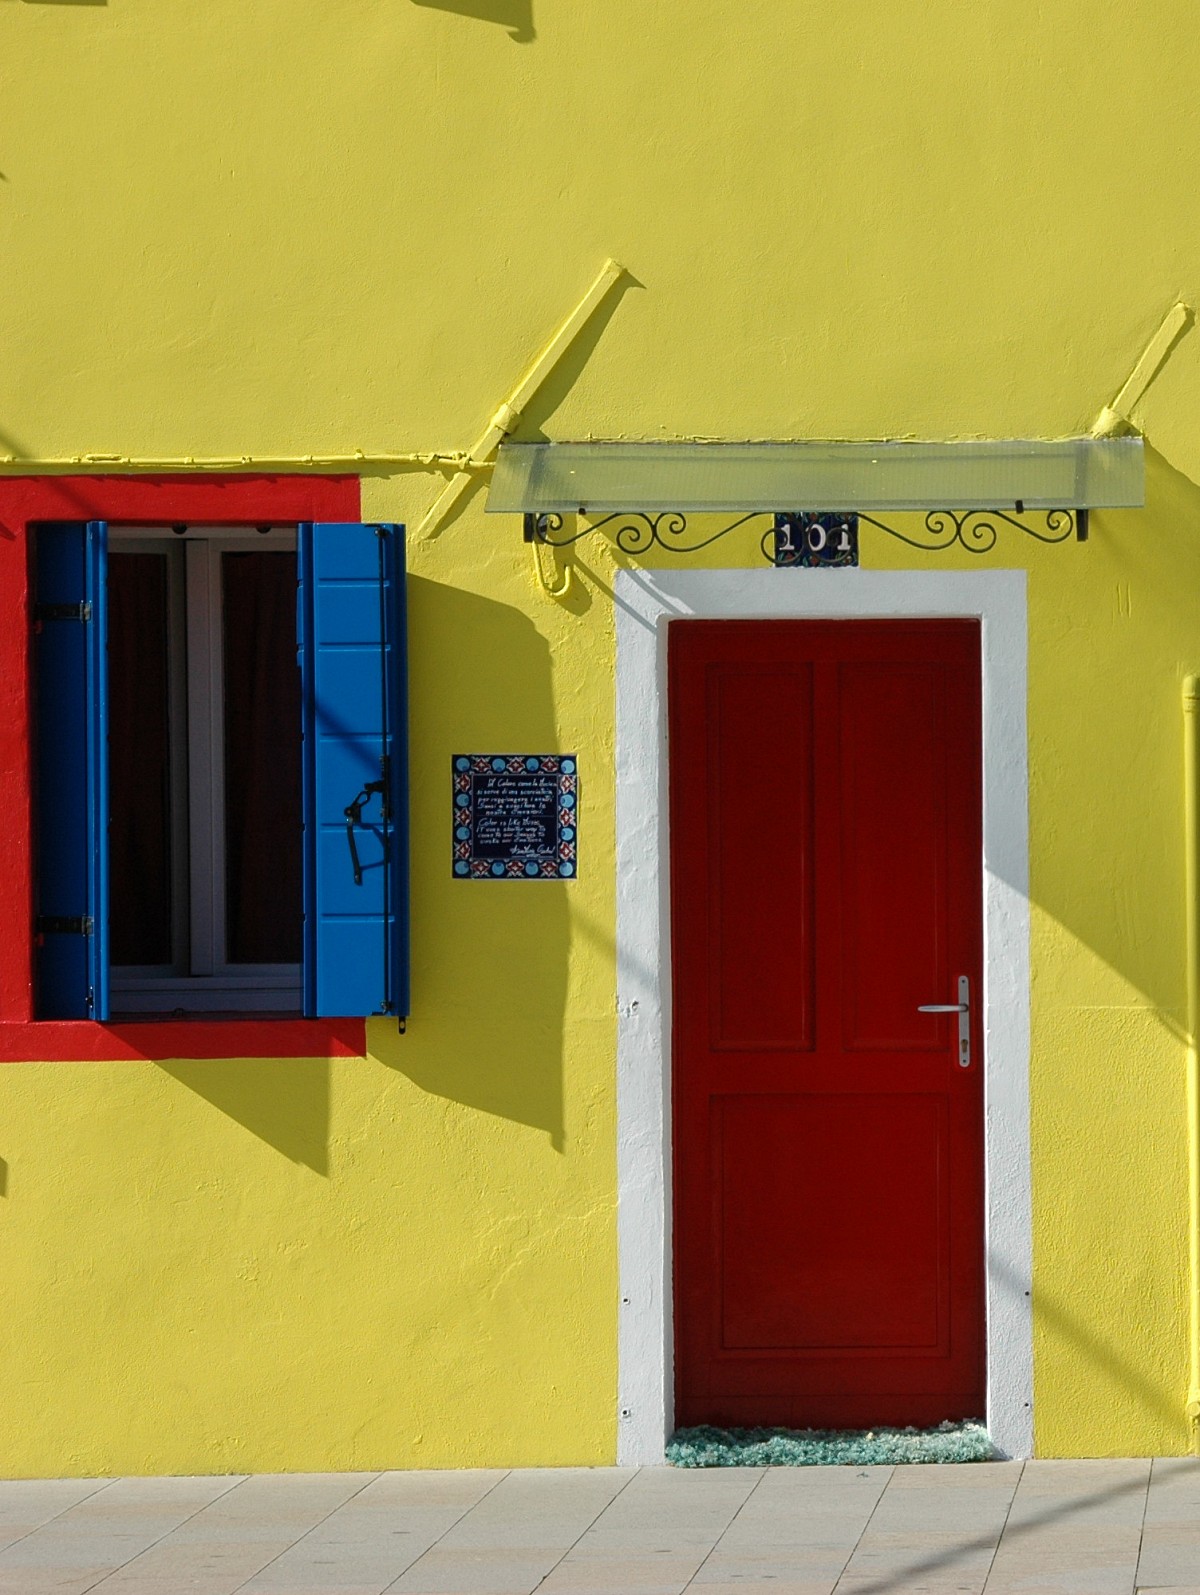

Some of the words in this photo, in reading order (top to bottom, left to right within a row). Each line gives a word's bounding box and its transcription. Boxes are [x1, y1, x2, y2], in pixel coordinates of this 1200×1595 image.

[779, 523, 851, 552] 101
[497, 778, 516, 787] Colore
[477, 797, 490, 805] per
[490, 796, 528, 804] raggiungere
[478, 817, 498, 826] Color
